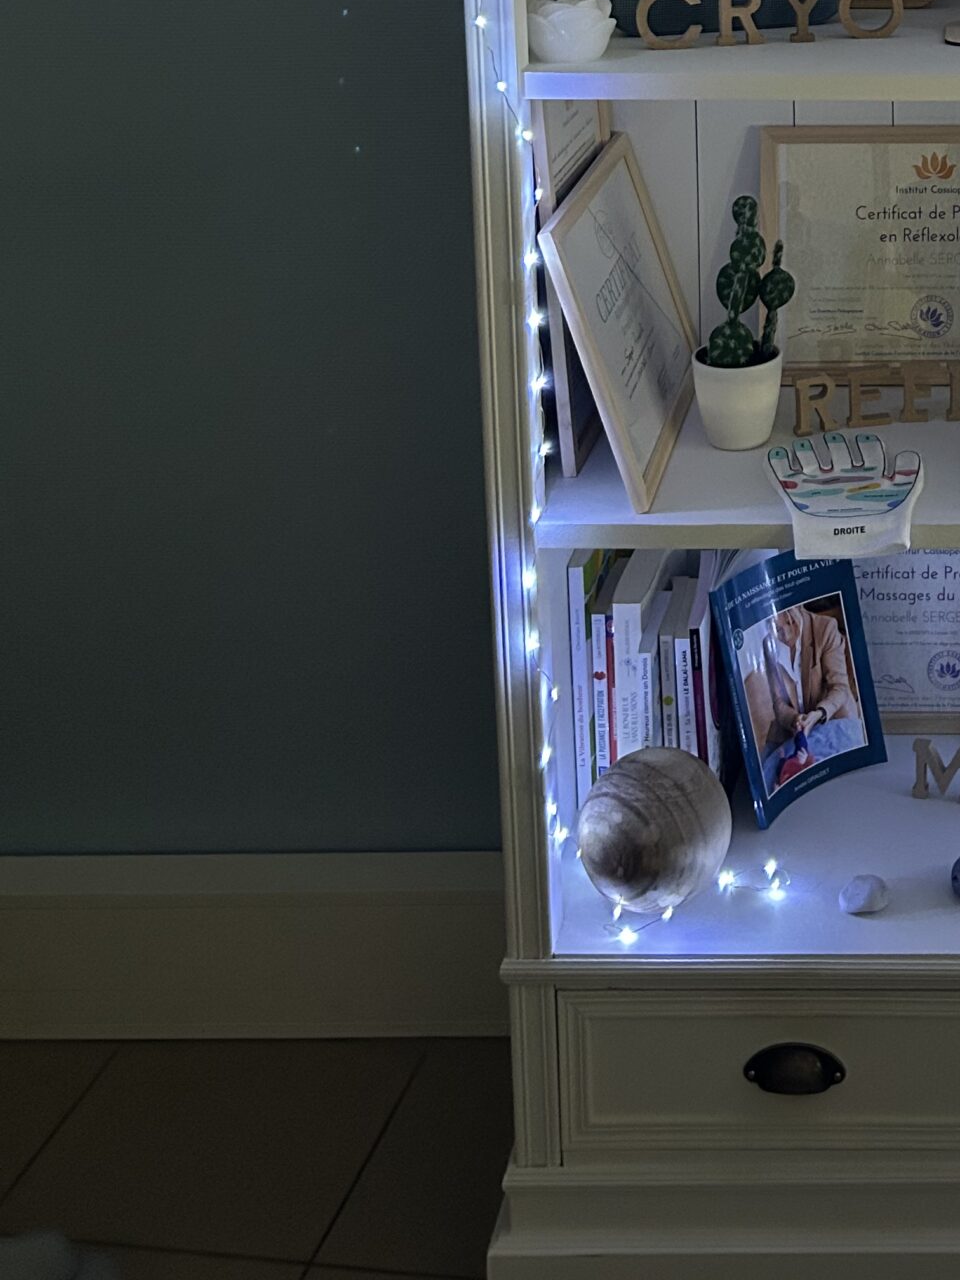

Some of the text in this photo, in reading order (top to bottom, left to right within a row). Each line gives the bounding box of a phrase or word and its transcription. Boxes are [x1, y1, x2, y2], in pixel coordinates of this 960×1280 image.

[895, 185, 927, 194] Institut
[855, 204, 923, 221] Certificat
[928, 204, 946, 220] de
[879, 232, 897, 243] en
[867, 252, 925, 266] Annabelle
[833, 525, 866, 536] DROITE
[776, 572, 786, 583] ET
[787, 565, 809, 579] POUR
[809, 561, 820, 572] LA
[852, 565, 916, 580] Certificat
[921, 564, 938, 580] de
[860, 587, 932, 605] Massages
[937, 586, 955, 602] du
[862, 611, 918, 624] Annabelle
